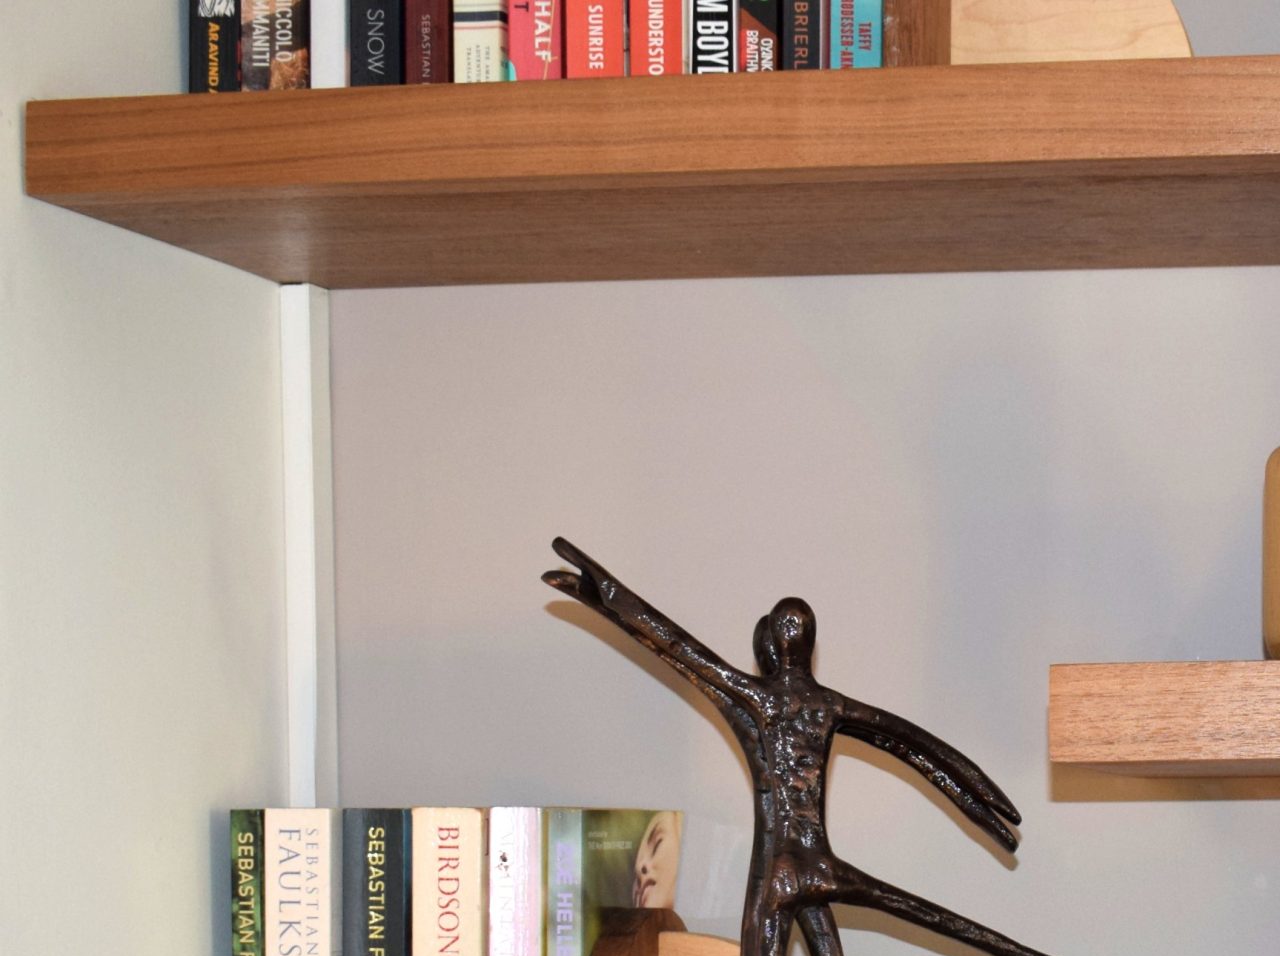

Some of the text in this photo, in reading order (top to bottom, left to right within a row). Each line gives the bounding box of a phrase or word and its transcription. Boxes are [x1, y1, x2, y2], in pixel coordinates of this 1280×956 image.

[207, 21, 221, 87] ARAVIND
[367, 8, 385, 75] SNOW
[421, 14, 431, 78] SEBASTIAN
[534, 1, 552, 62] HALF
[588, 4, 604, 70] SUNRISE
[858, 22, 872, 51] TAFFY
[237, 832, 256, 944] SEBASTIAN
[305, 827, 320, 956] SEBASTIAN
[367, 826, 386, 940] SEBASTIAN
